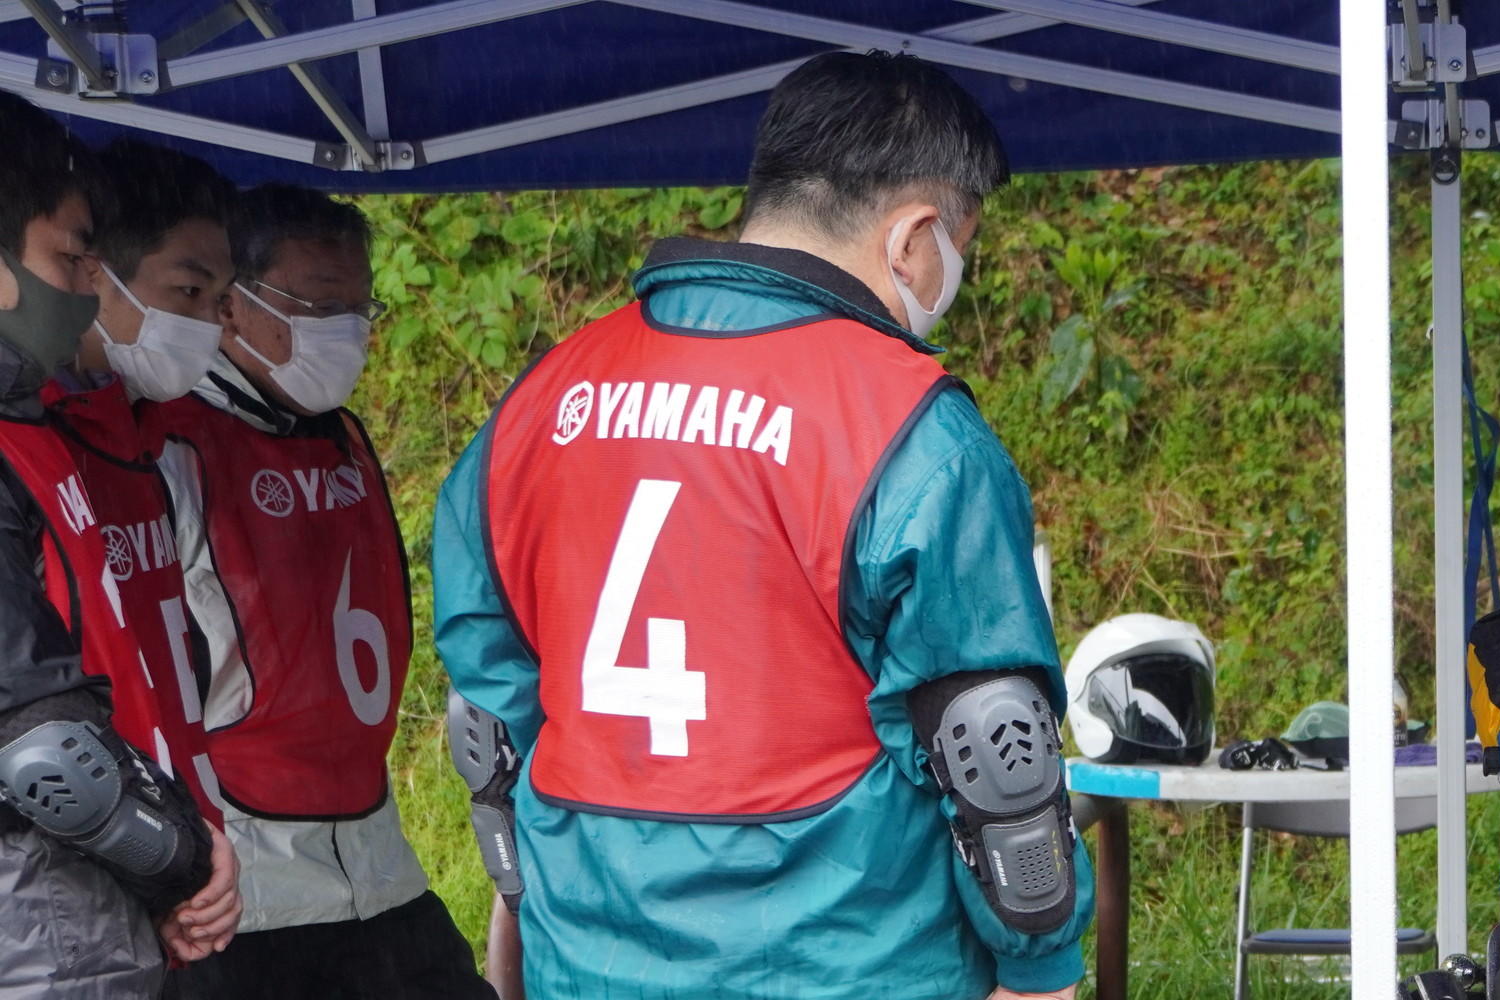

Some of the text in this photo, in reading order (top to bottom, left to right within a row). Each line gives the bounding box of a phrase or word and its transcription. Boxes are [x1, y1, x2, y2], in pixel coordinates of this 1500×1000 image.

[596, 381, 794, 467] YAMAHA
[333, 544, 391, 726] 6
[581, 479, 706, 757] 4
[494, 833, 509, 863] YAMAHA
